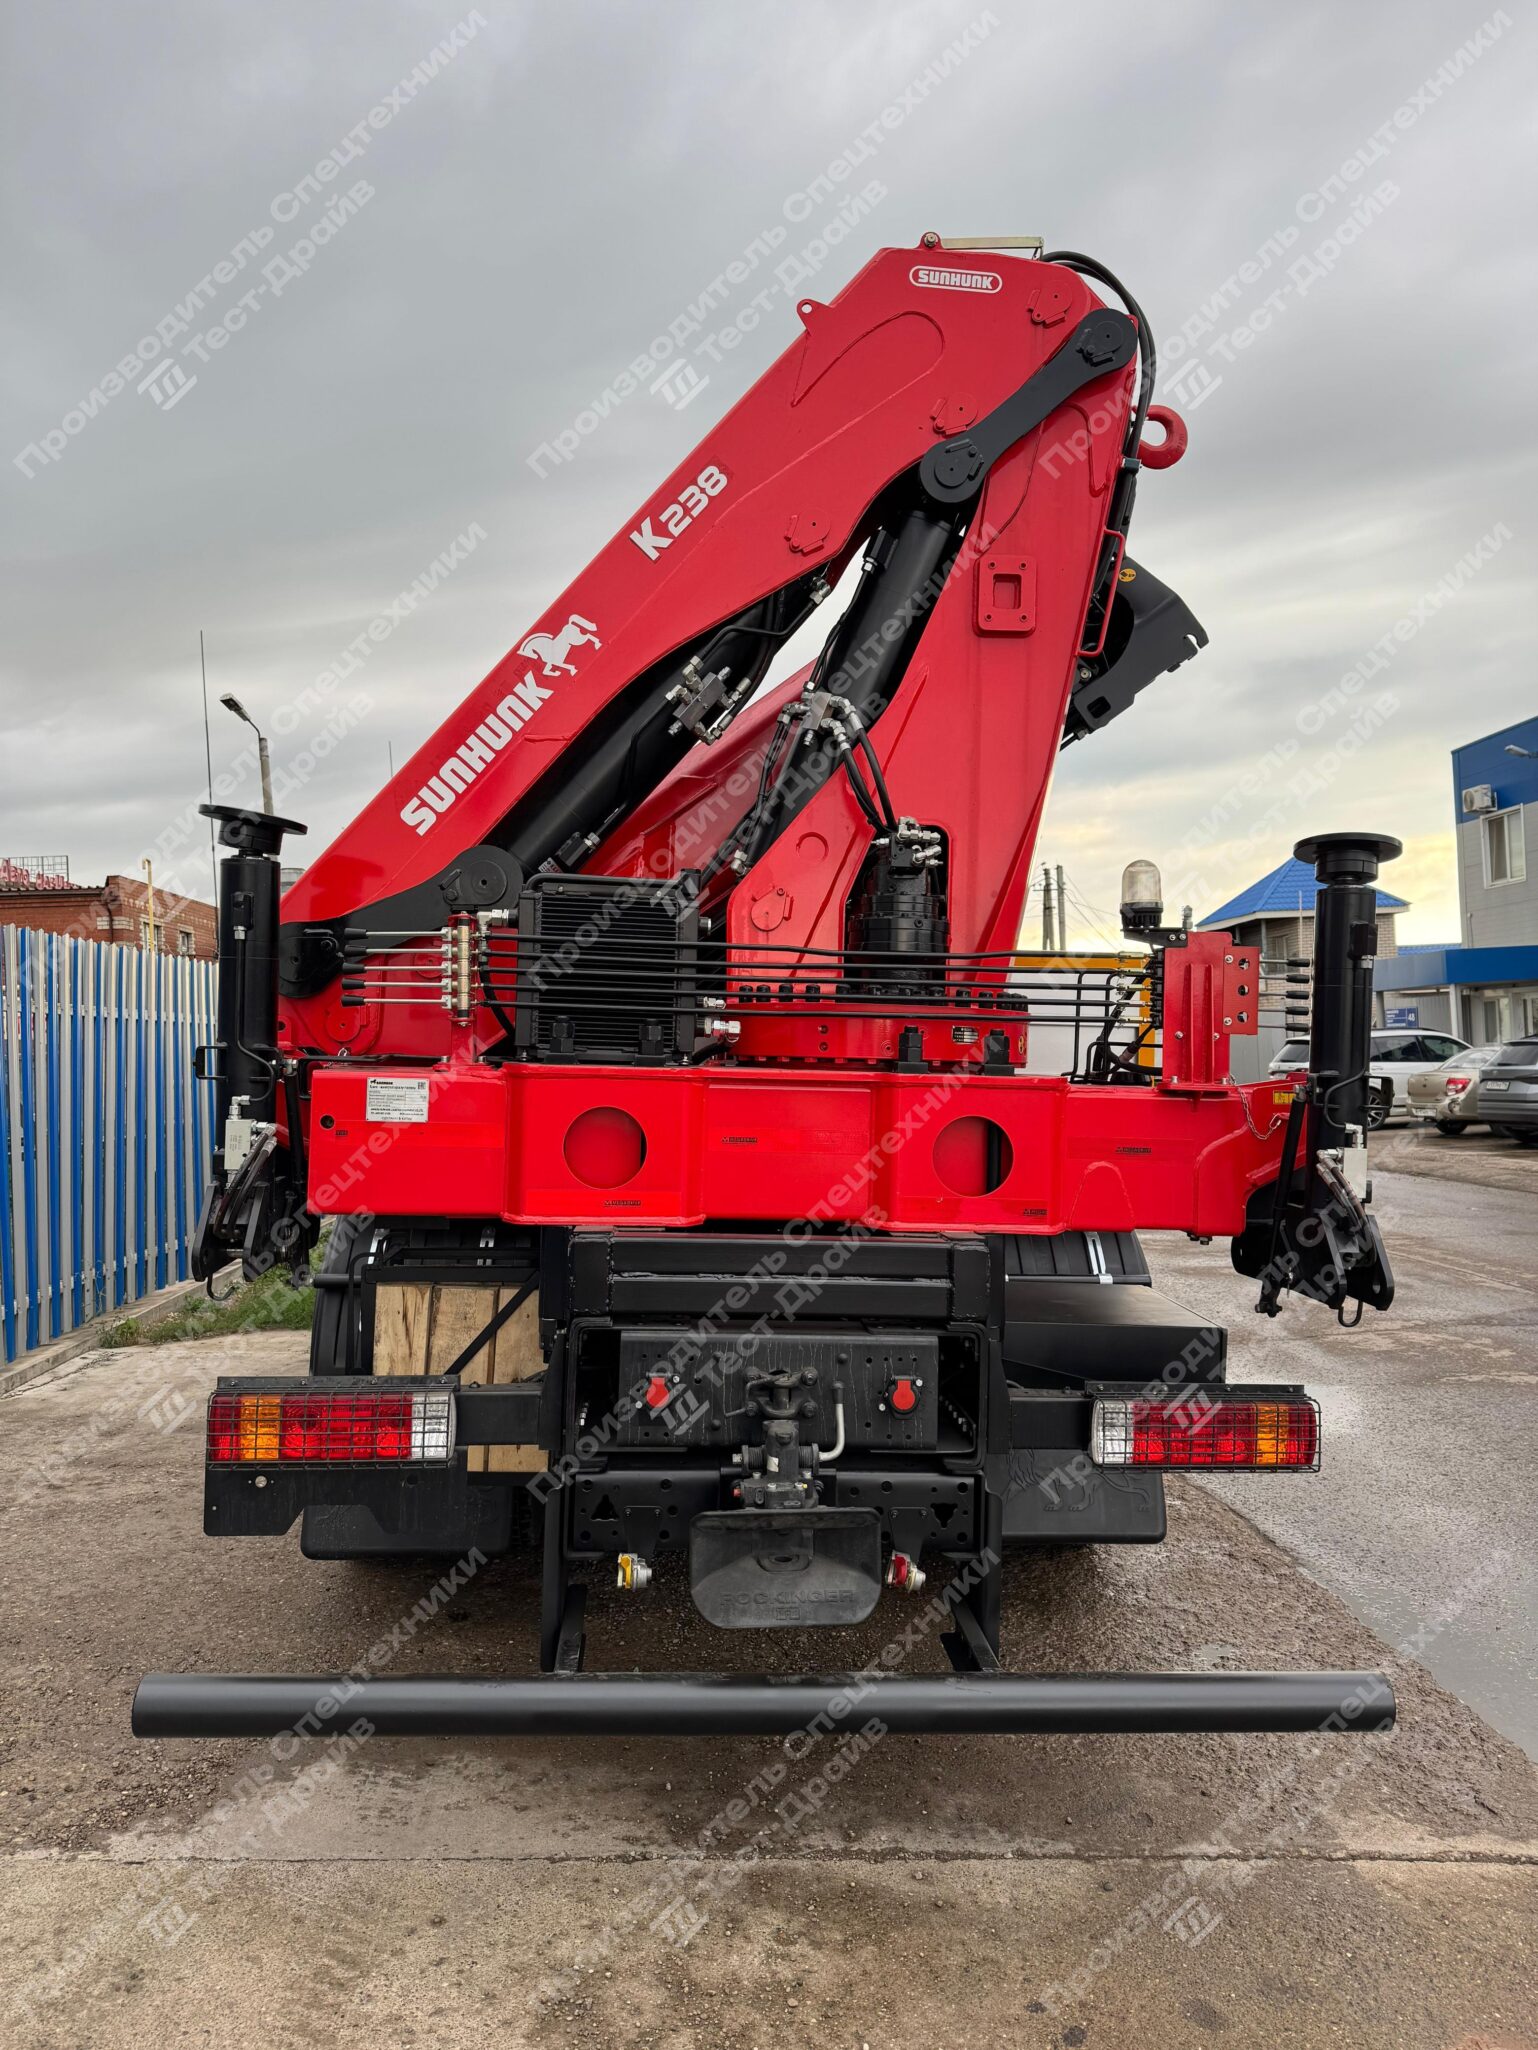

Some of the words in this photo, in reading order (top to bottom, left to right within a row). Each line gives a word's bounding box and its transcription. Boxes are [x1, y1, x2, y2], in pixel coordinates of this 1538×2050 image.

[918, 270, 994, 289] SUNHUNK
[629, 465, 728, 561] K238
[400, 670, 555, 837] SUNHUNK
